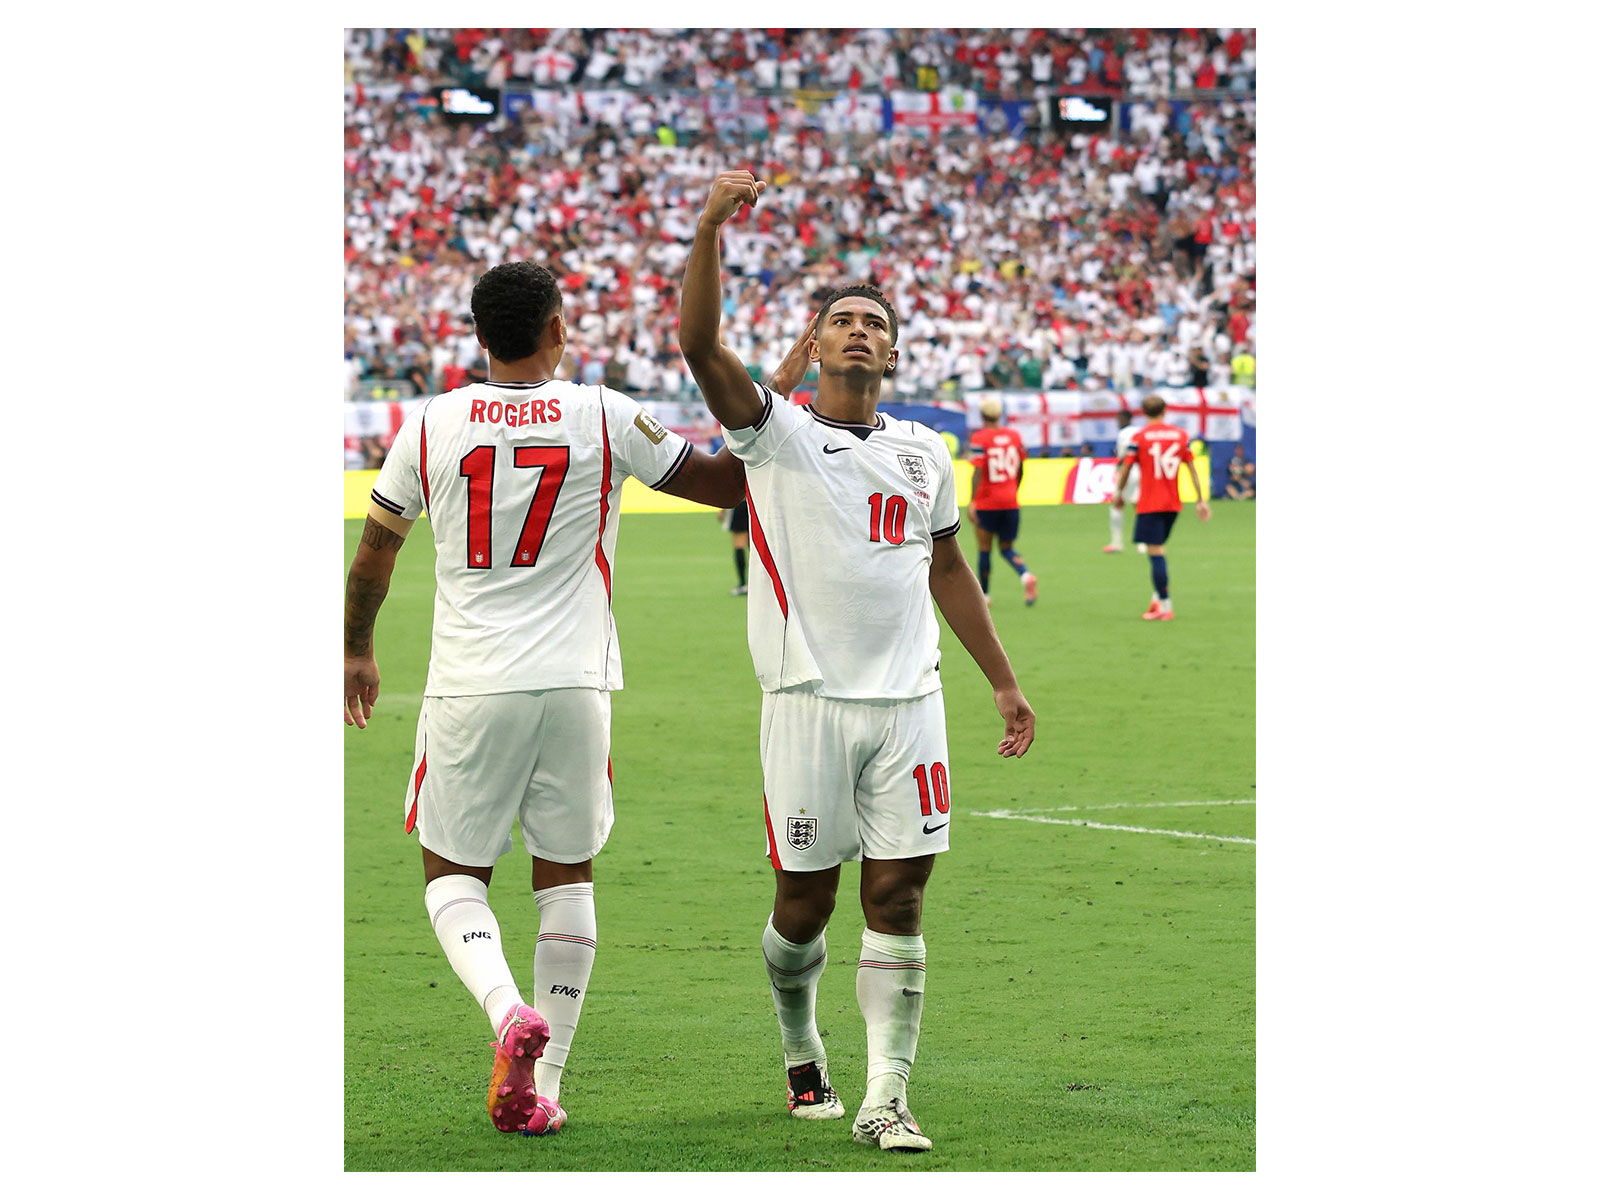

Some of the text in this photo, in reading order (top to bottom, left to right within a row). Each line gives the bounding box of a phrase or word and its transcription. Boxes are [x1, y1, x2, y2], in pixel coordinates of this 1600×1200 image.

[470, 398, 562, 428] ROGERS
[1148, 441, 1180, 480] 16
[459, 445, 571, 569] 17
[867, 492, 908, 545] 10
[912, 761, 950, 816] 10
[462, 930, 492, 943] ENG
[550, 984, 581, 999] ENG
